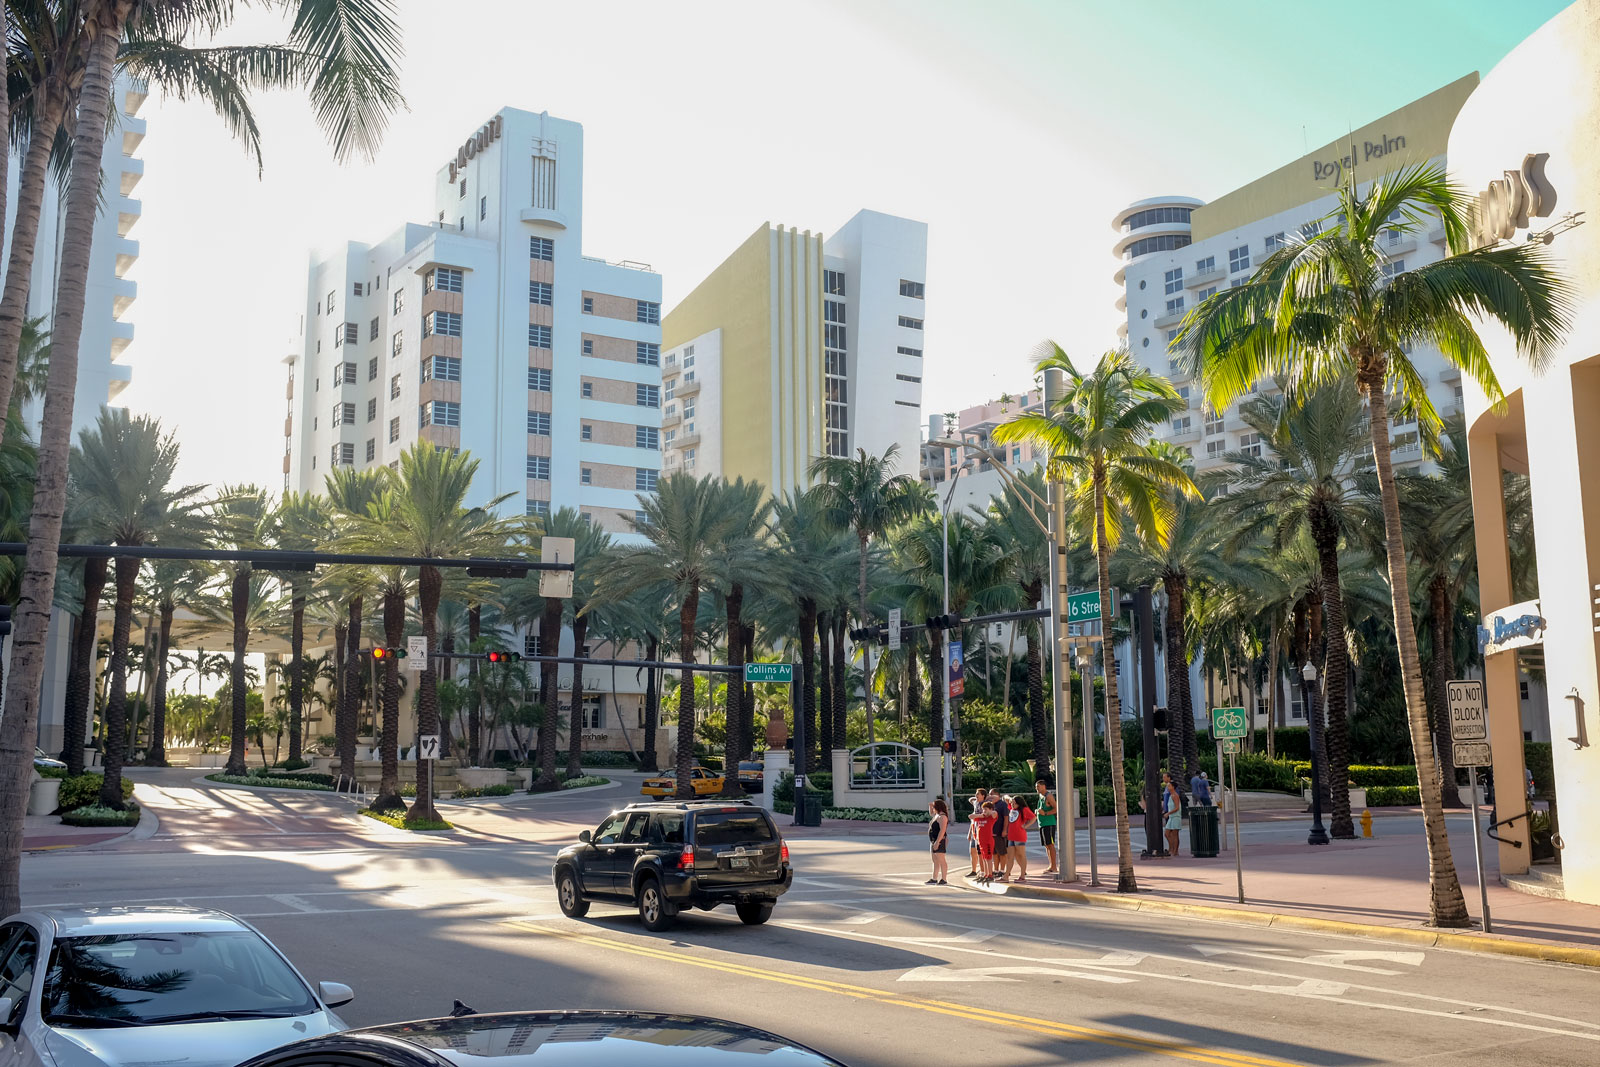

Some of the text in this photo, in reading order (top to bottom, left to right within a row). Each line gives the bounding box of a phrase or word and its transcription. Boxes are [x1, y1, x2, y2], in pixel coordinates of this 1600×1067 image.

[1313, 134, 1406, 187] Royal Palm
[1067, 601, 1101, 617] 16 Stre
[747, 665, 791, 674] Collins Av
[1450, 687, 1481, 702] DO NOT
[1454, 707, 1482, 721] BLOCK
[1228, 728, 1244, 736] ROUTE
[1454, 724, 1485, 735] INTERSECTION
[582, 732, 609, 741] exhale
